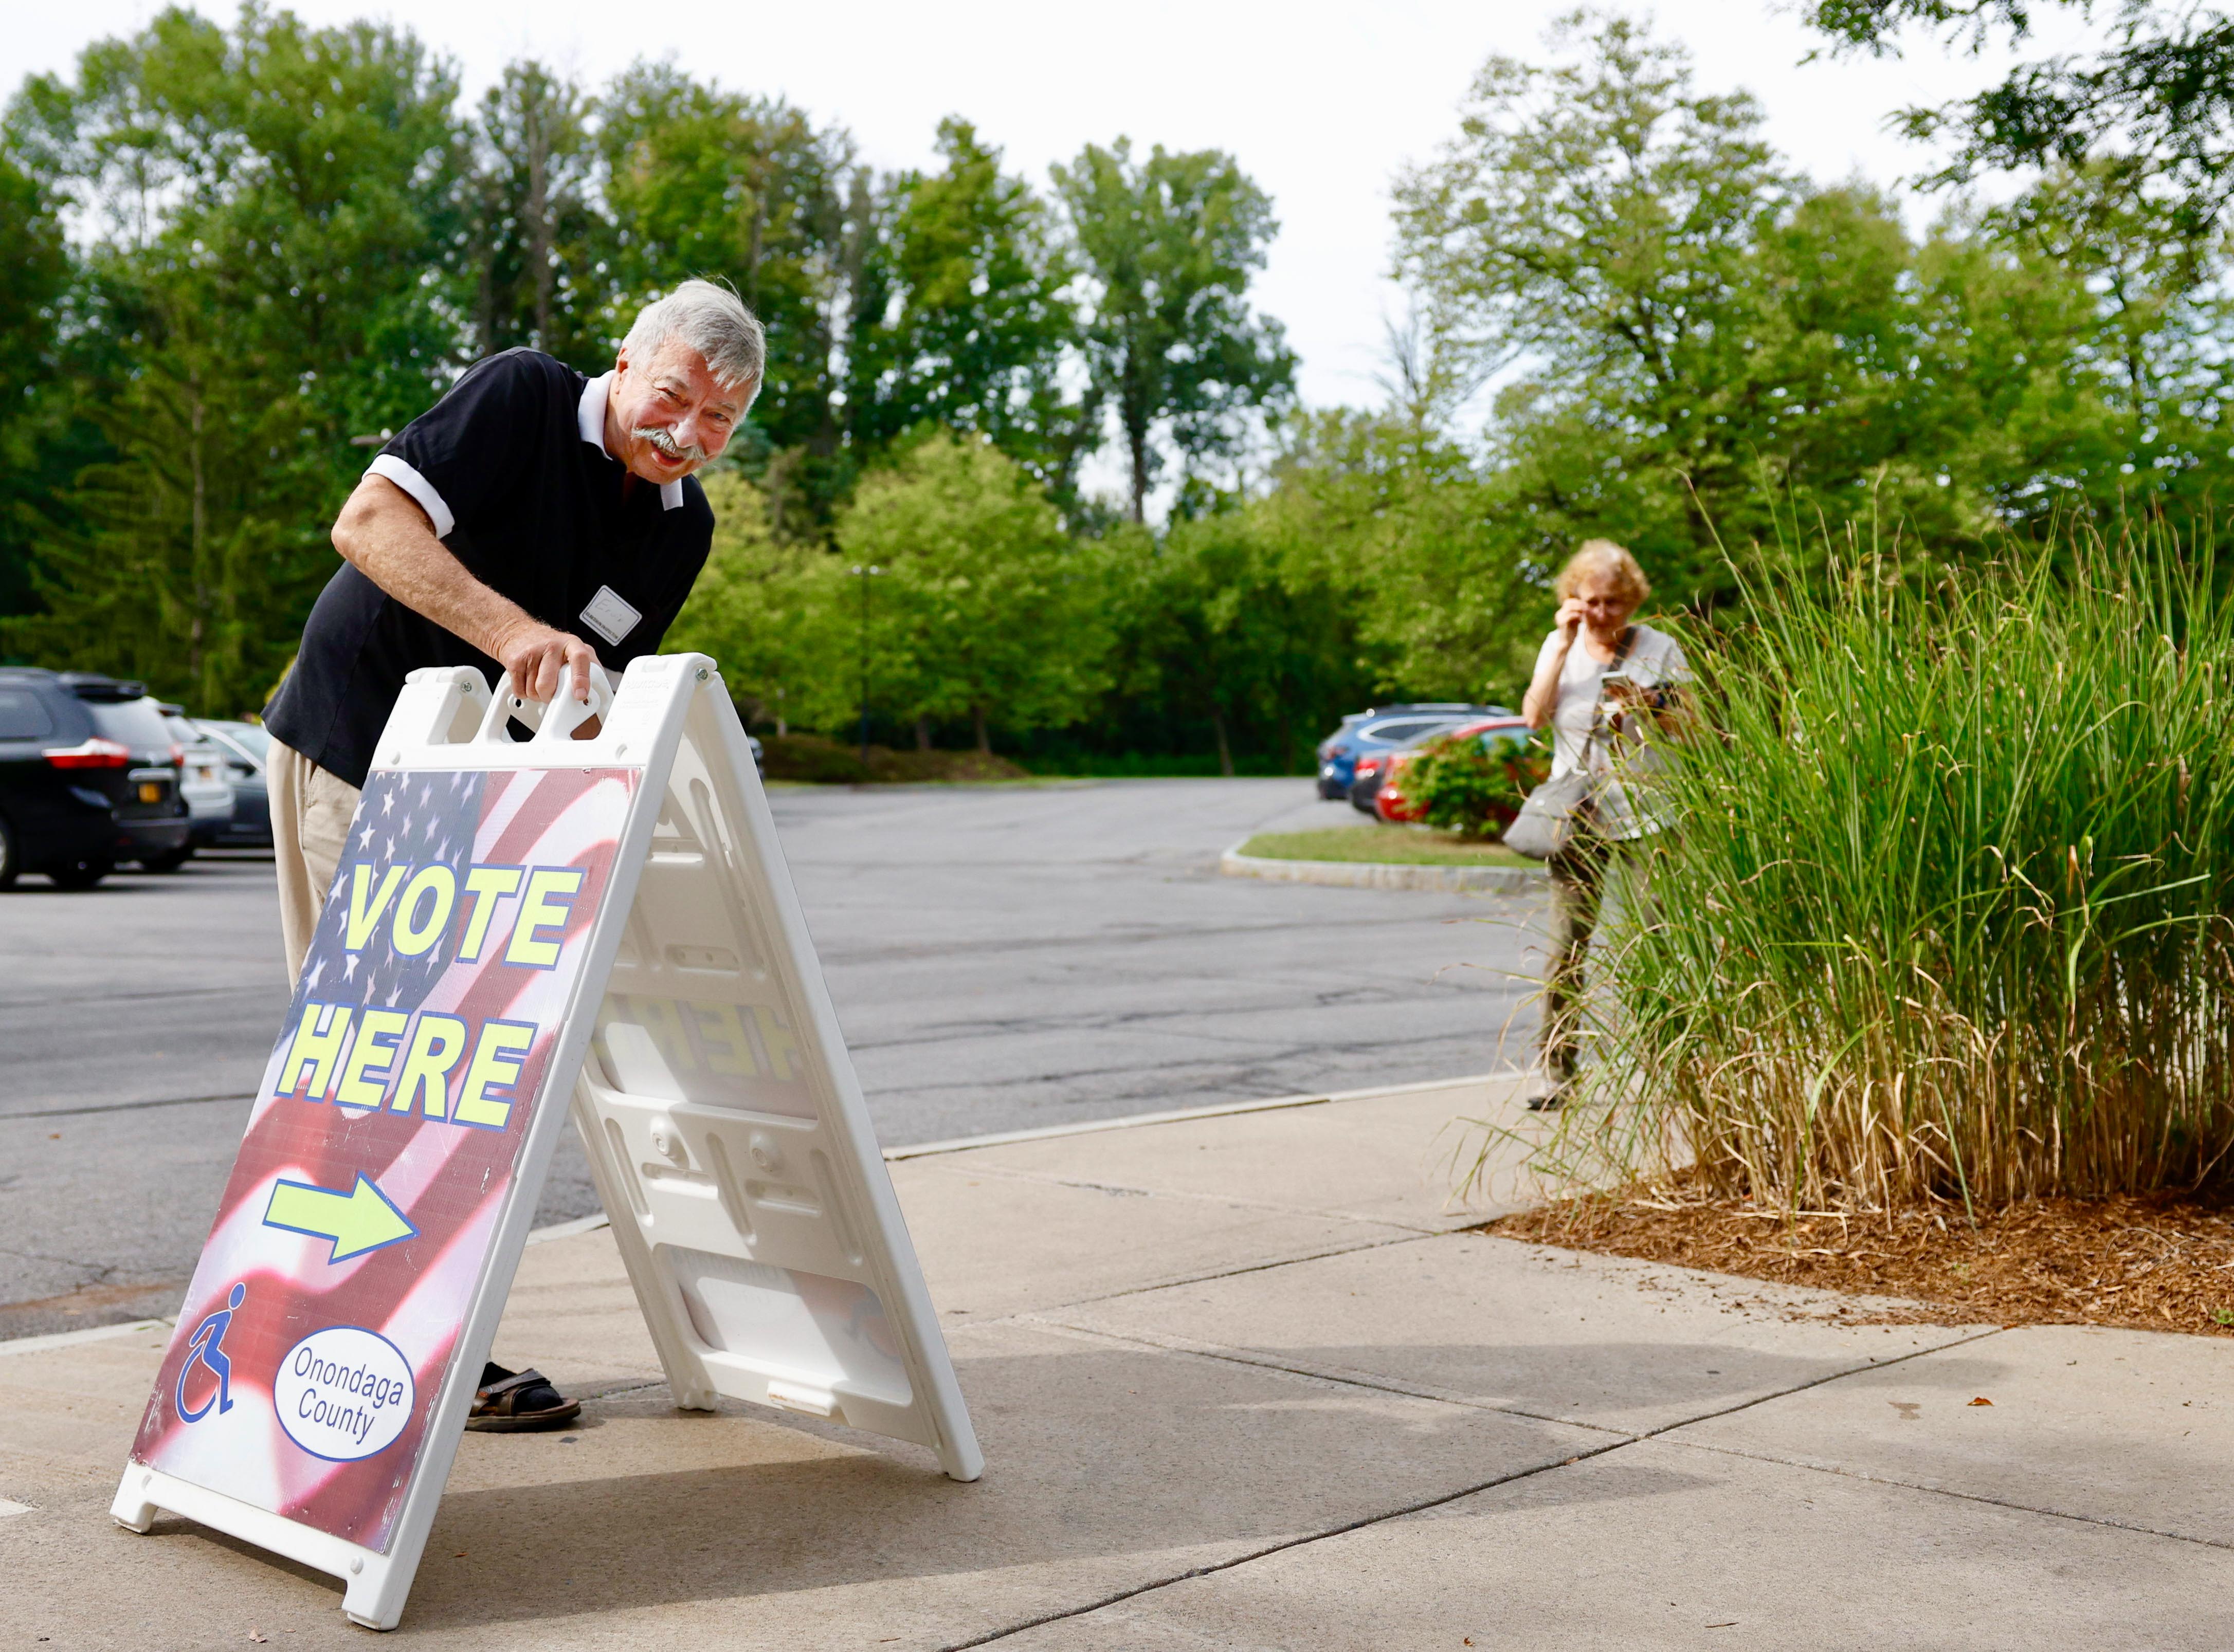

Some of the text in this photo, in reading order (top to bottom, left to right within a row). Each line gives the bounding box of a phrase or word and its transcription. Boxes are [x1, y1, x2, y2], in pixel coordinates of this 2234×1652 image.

[341, 859, 587, 971] VOTE
[274, 999, 539, 1132] HERE
[295, 1347, 404, 1409] Onondaga
[299, 1388, 375, 1445] County
